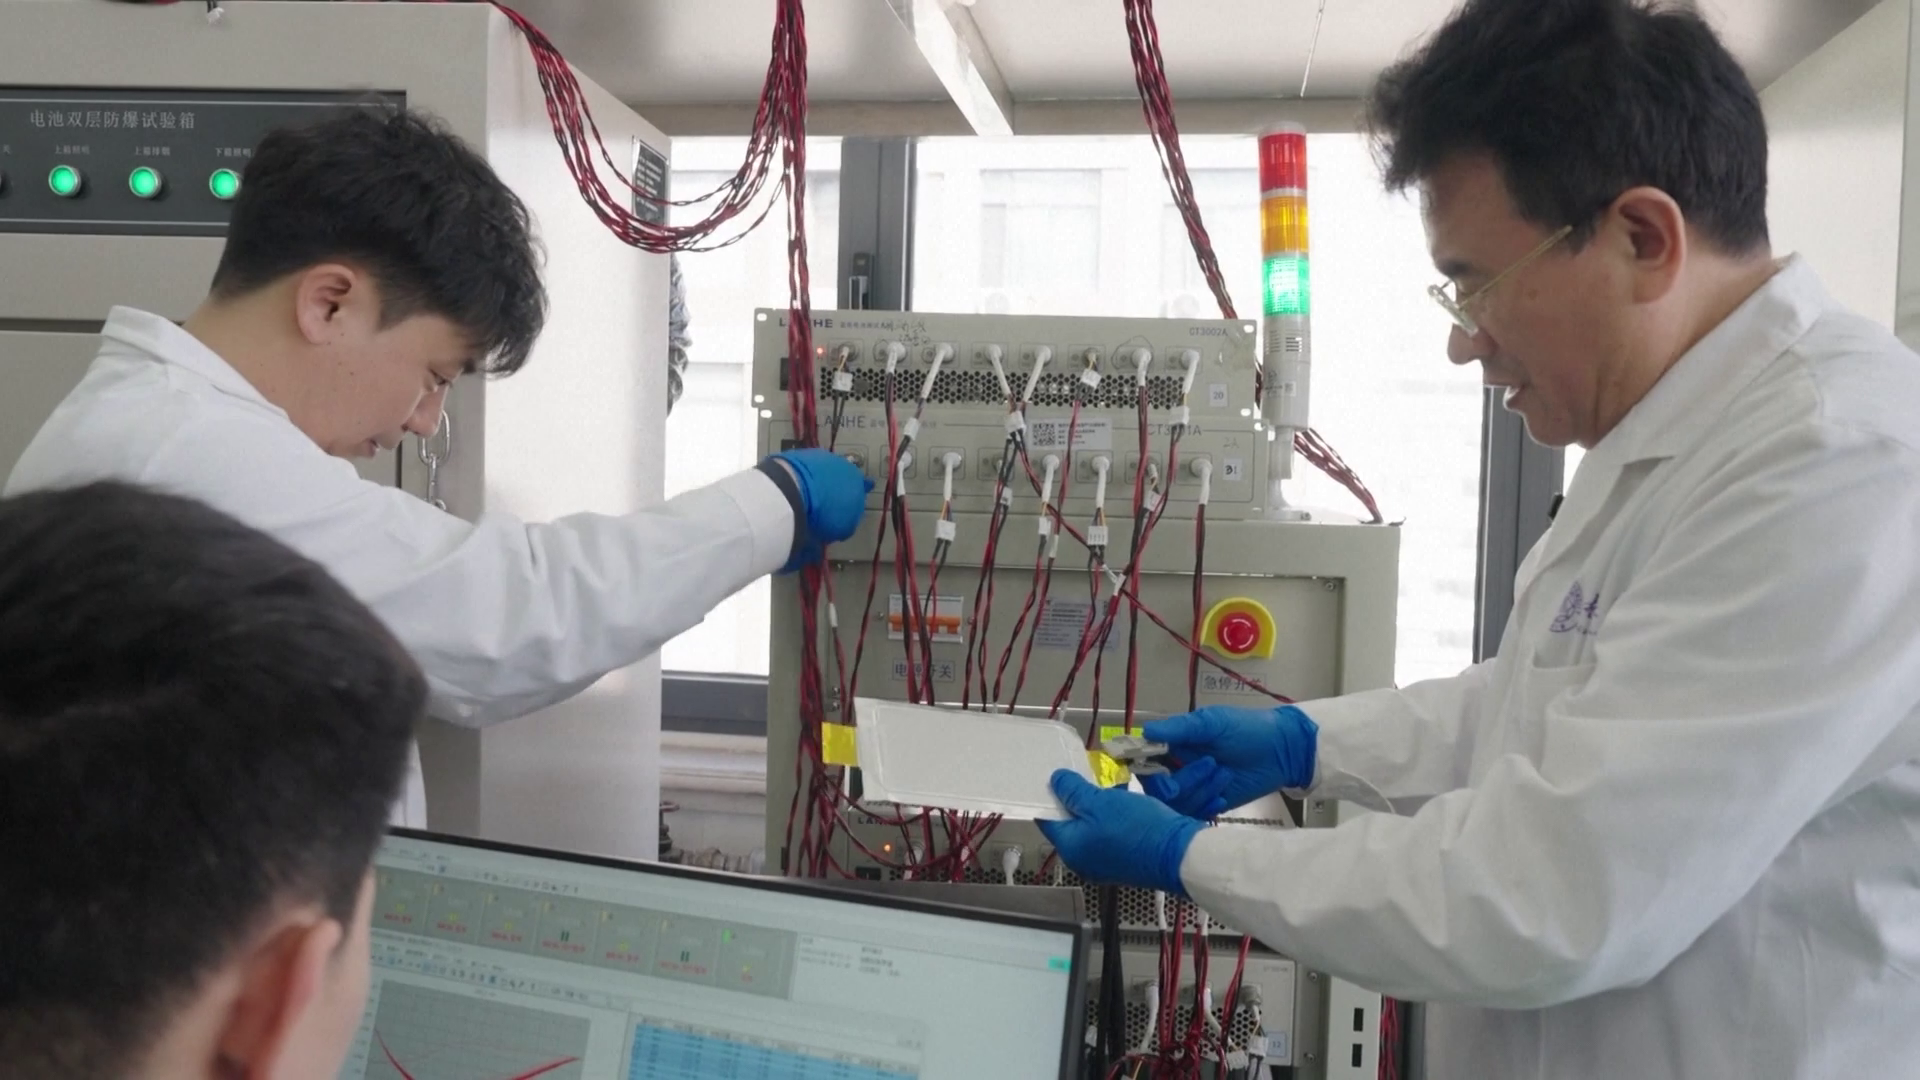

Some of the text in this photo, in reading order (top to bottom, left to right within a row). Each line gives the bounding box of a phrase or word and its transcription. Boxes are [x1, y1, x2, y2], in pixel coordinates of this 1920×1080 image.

[30, 110, 196, 129] 电池双层防爆试验箱
[779, 318, 833, 328] LHE
[1189, 327, 1228, 336] CT3002A
[1213, 391, 1224, 400] 20
